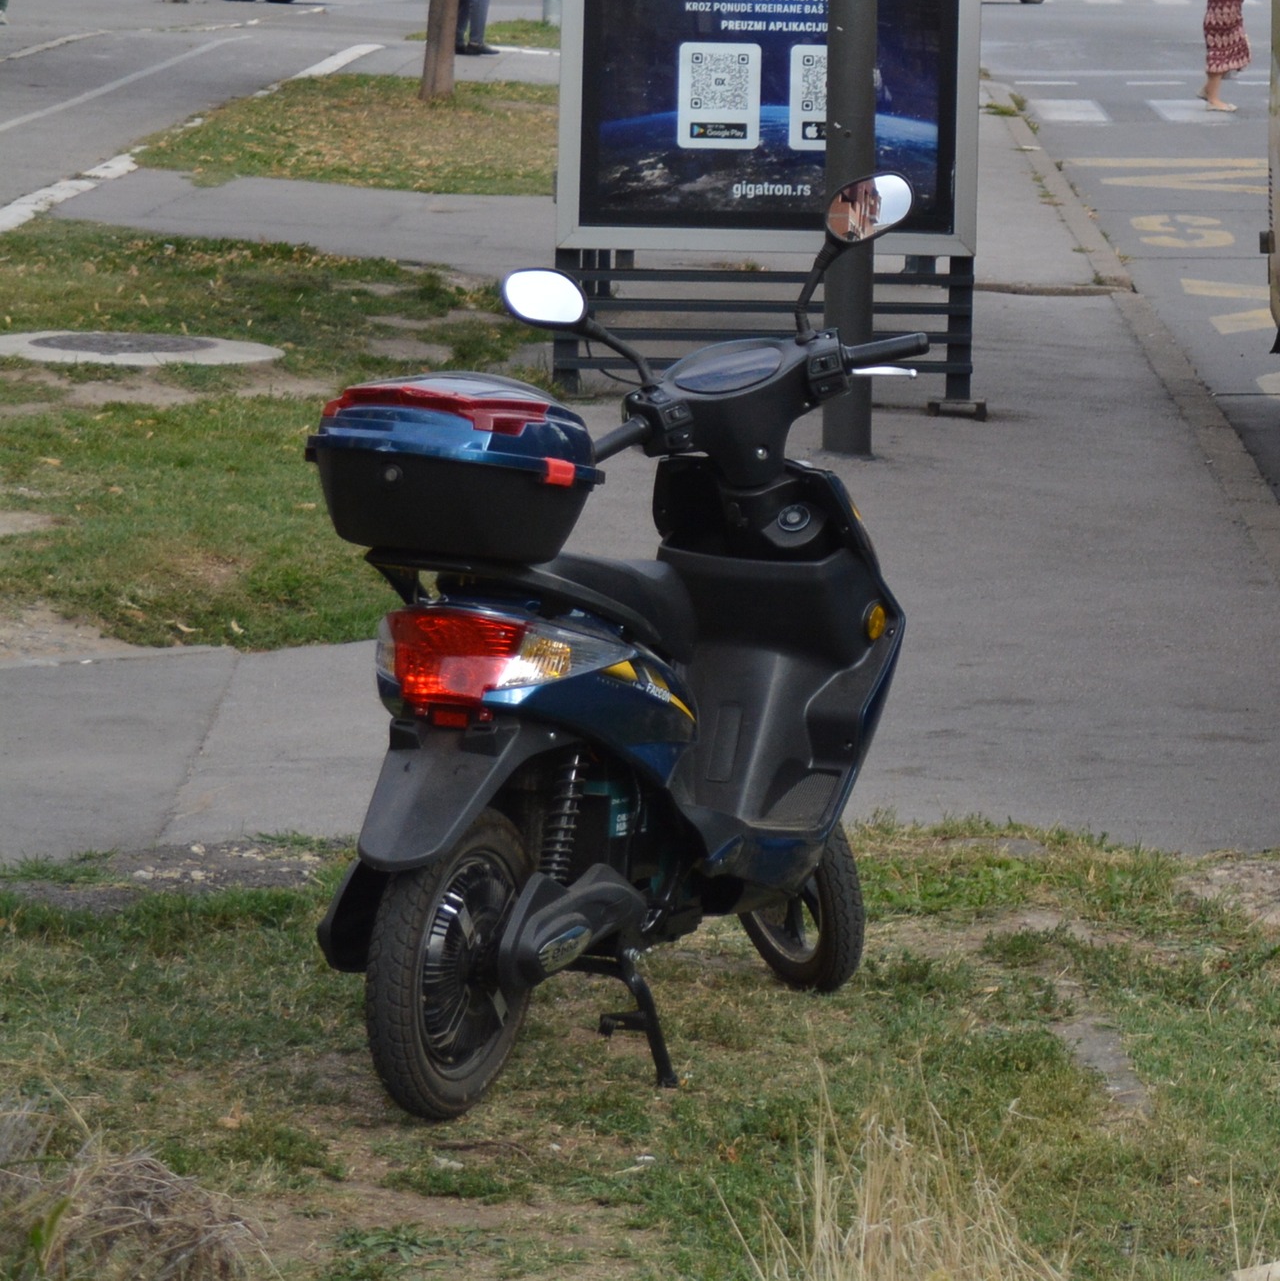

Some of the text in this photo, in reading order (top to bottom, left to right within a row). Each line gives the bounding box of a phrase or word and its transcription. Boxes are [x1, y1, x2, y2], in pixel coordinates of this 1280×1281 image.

[685, 2, 711, 11] KROZ
[714, 3, 752, 12] PONUDE
[755, 4, 802, 14] KREIRANE
[804, 4, 824, 14] BAŠ
[721, 20, 829, 32] PREUZMI APLIKACIJU
[732, 181, 811, 198] gigatron.rs
